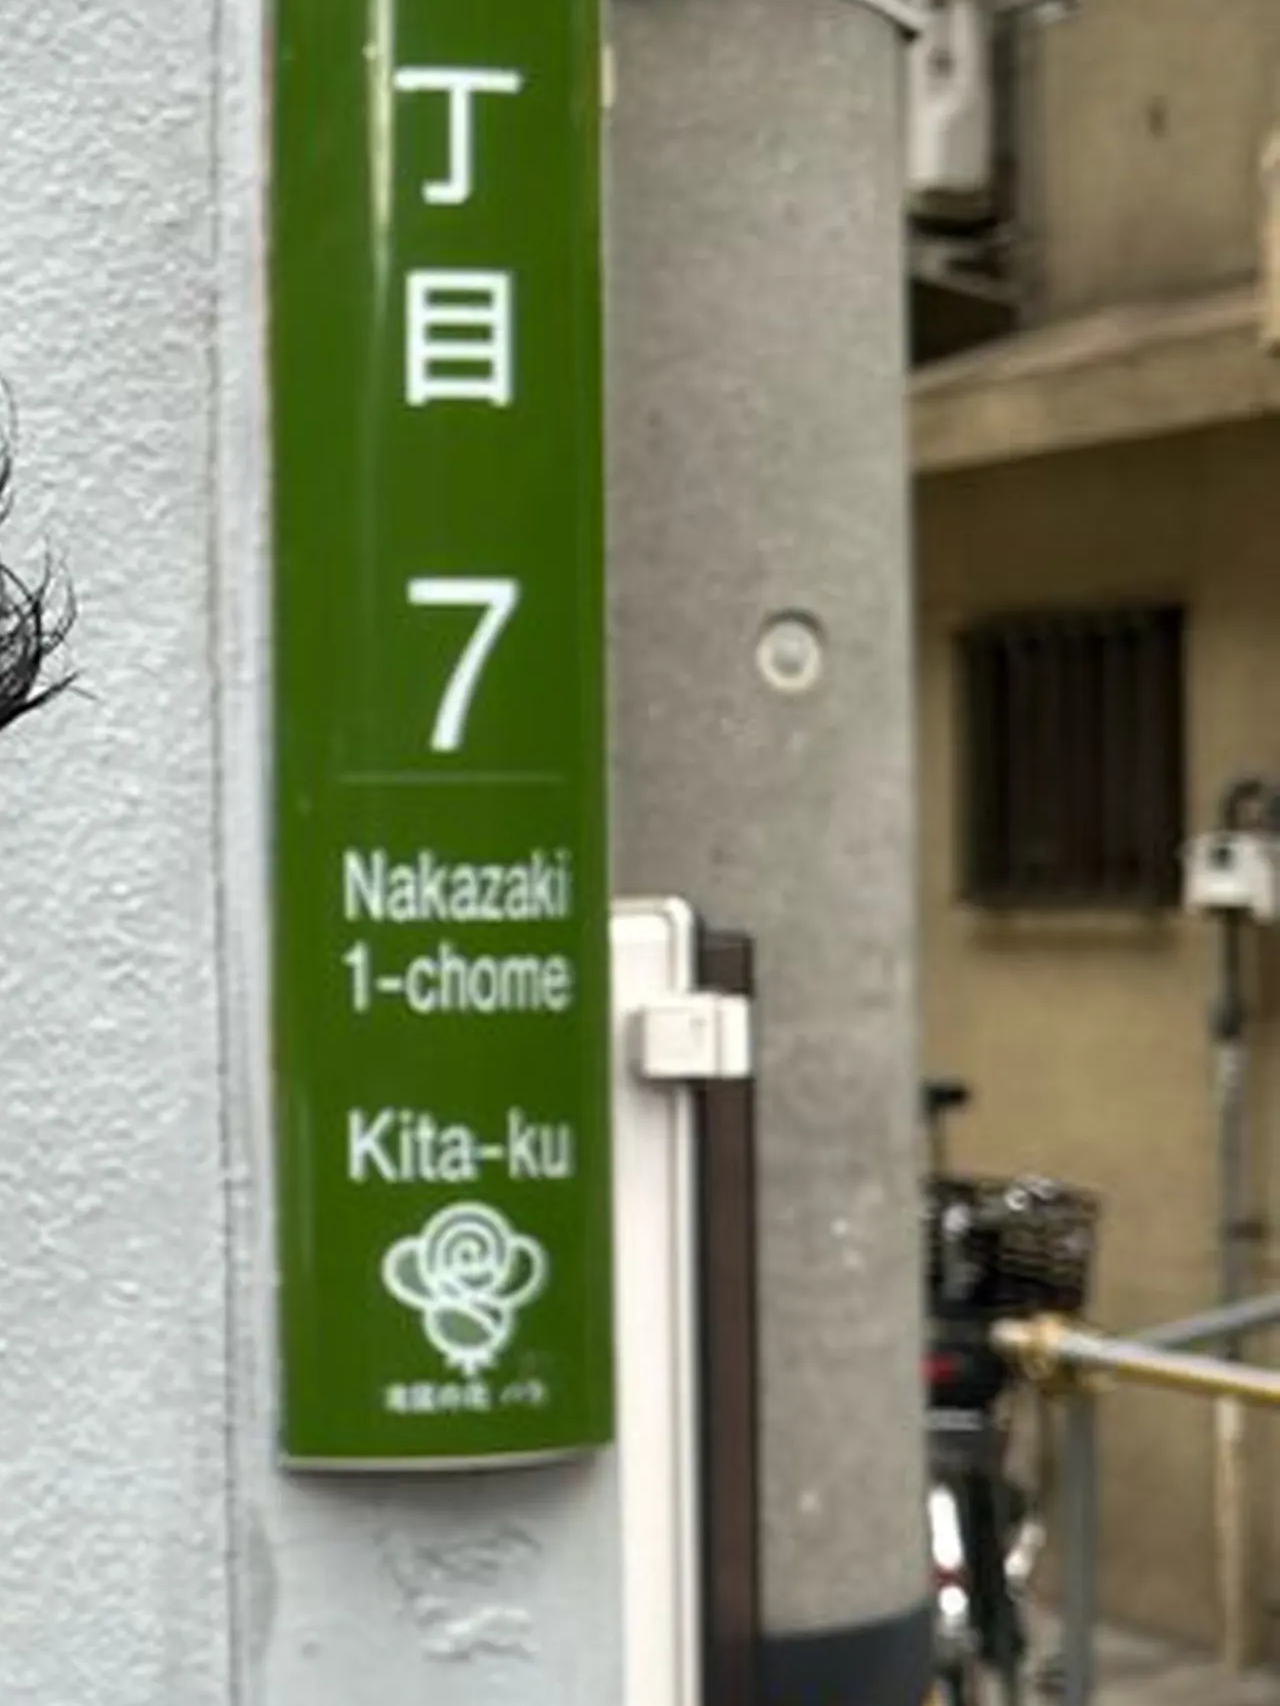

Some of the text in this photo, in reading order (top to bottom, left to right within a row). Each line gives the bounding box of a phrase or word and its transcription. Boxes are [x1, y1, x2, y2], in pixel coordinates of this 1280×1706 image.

[407, 577, 520, 752] 7
[343, 848, 570, 923] Nakazaki
[343, 940, 573, 1012] 1-chome
[348, 1105, 574, 1182] Kita-ku
